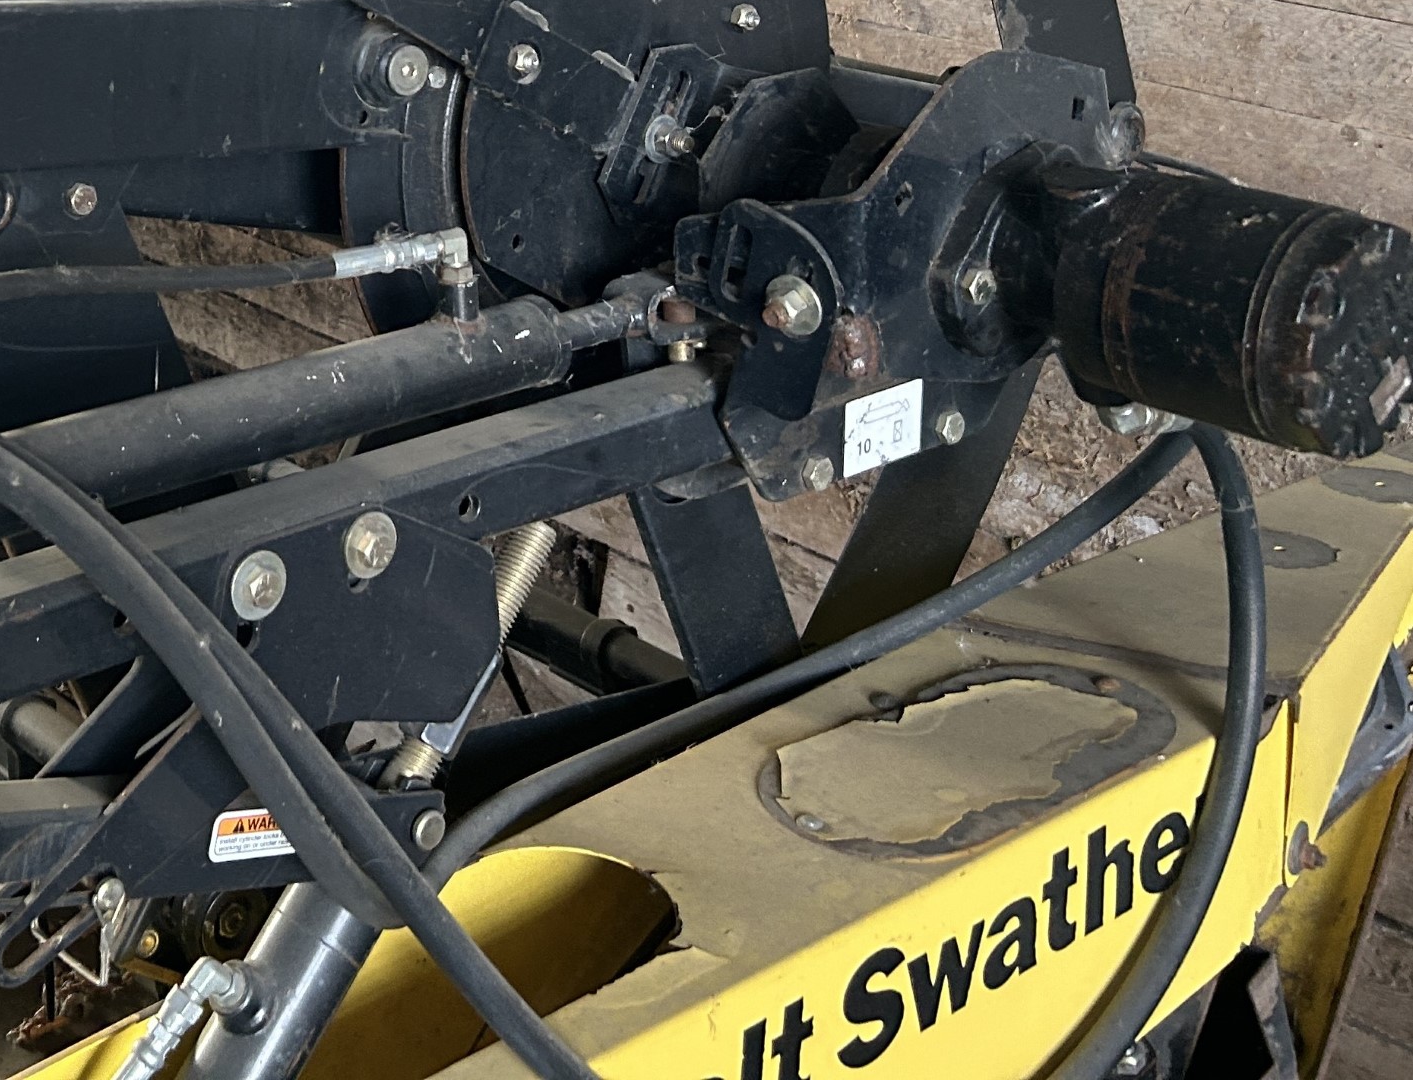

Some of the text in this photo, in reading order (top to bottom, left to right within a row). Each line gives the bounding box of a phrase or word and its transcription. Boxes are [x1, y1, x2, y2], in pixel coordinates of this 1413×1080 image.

[857, 438, 871, 456] 10
[248, 816, 278, 831] WAR
[699, 794, 1206, 1080] lt Swathe
